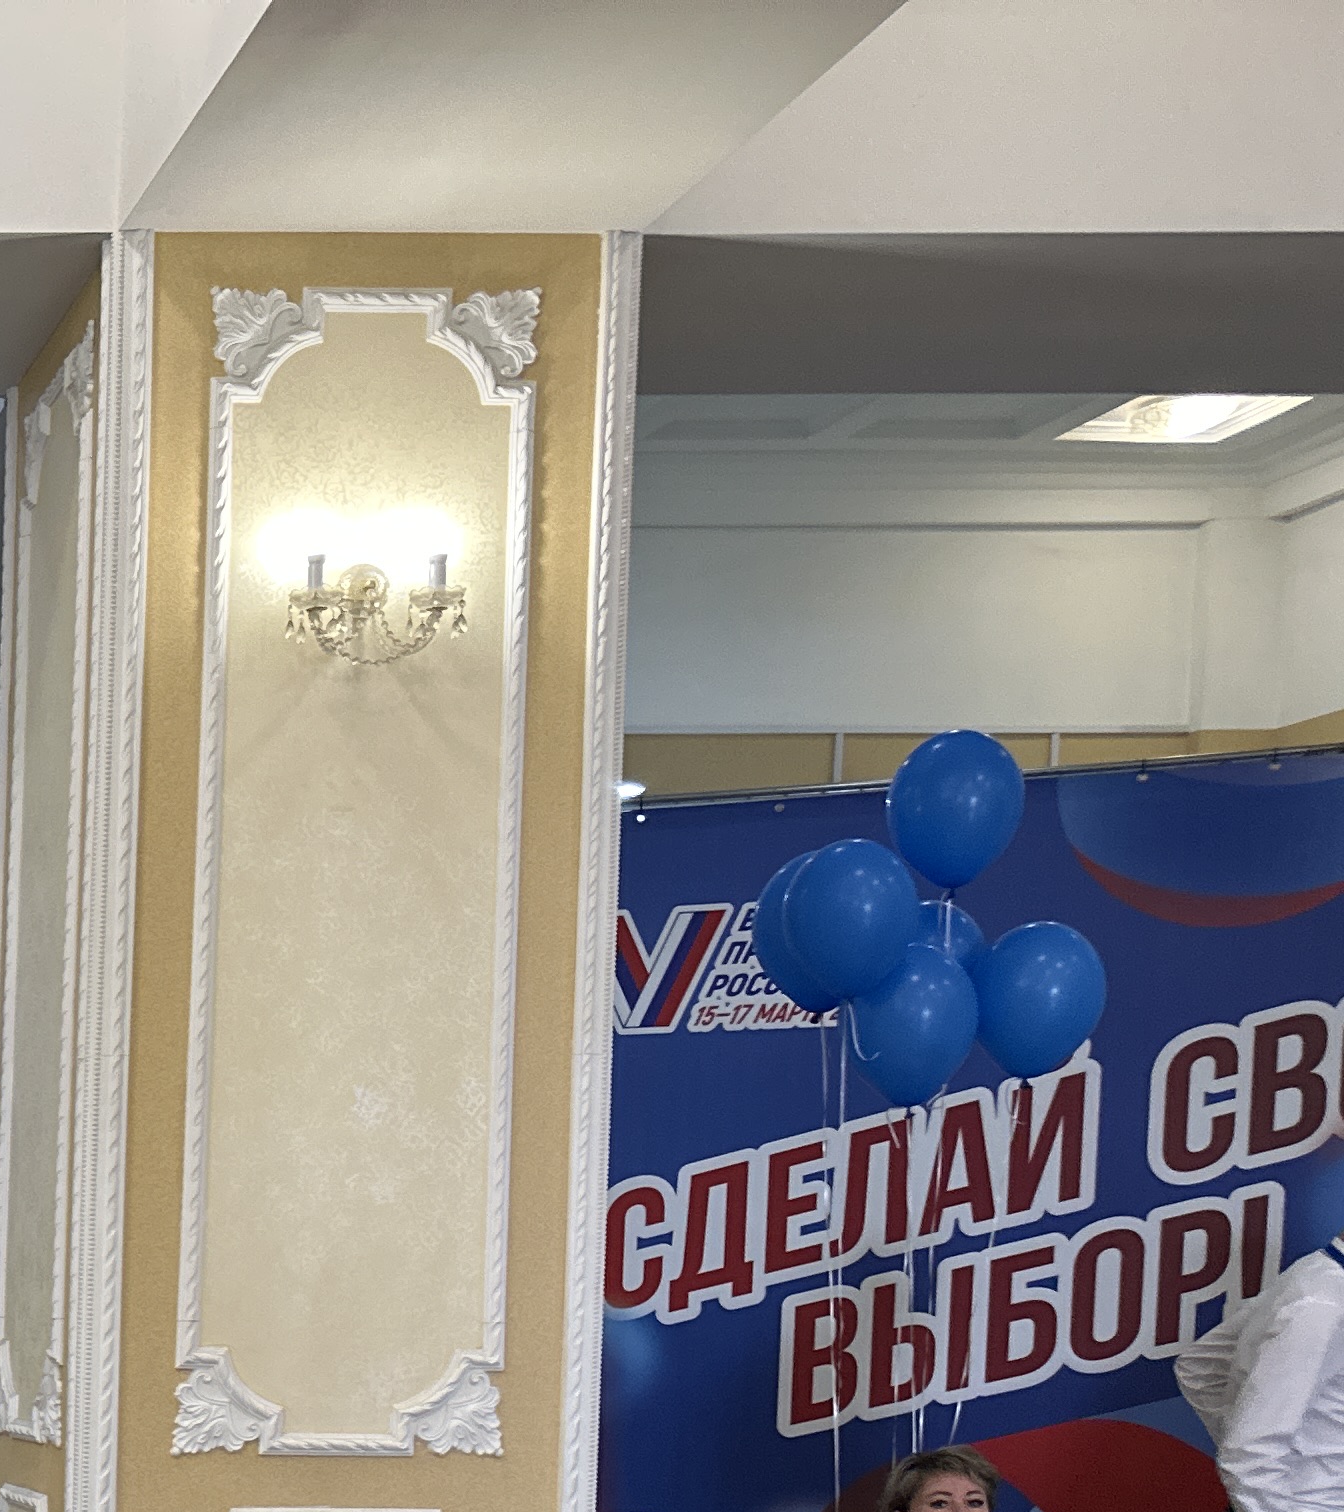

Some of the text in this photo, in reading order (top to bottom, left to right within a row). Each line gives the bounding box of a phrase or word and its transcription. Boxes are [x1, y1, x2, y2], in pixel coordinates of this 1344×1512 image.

[705, 972, 788, 999] РОСС
[602, 1010, 1344, 1314] СДЕЛАЙ СВ
